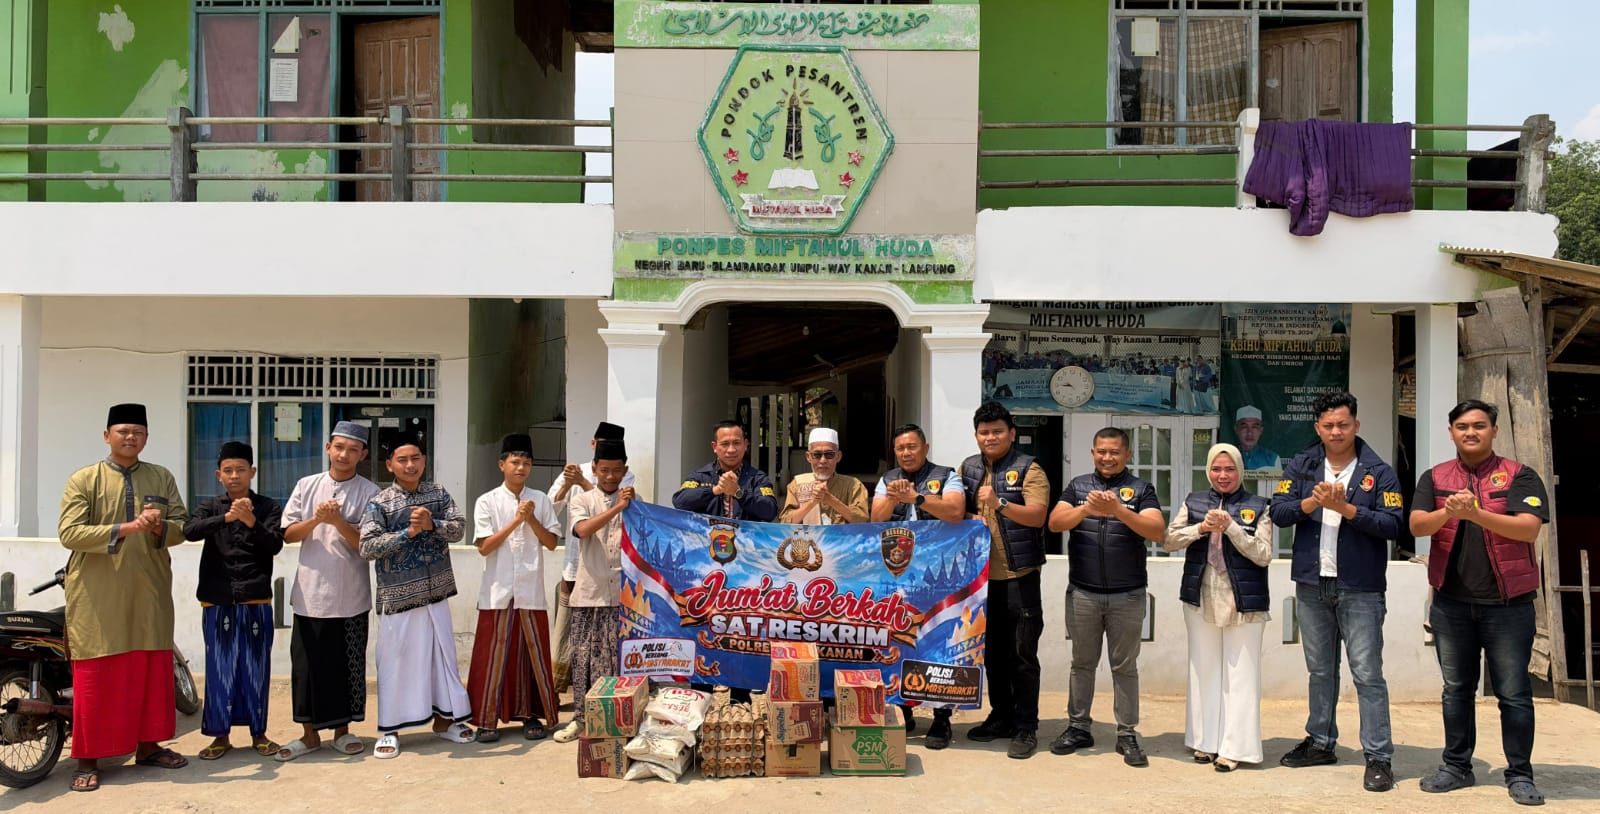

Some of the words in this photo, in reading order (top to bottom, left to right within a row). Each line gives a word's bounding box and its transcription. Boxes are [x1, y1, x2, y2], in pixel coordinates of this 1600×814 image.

[721, 68, 774, 138] PONDOK
[785, 64, 868, 141] PESANTREN
[657, 237, 746, 256] PONPES
[754, 237, 865, 257] MIFTAHUL
[874, 239, 935, 257] HUDA
[828, 263, 851, 274] WAY
[855, 264, 893, 274] KANAN
[901, 264, 956, 275] LAMPUNG
[1029, 313, 1102, 328] MIFTAHUL
[1106, 314, 1146, 328] HUDA
[994, 333, 1017, 341] Baru
[1103, 335, 1121, 345] Way
[1123, 335, 1152, 344] Kanan
[1158, 335, 1201, 345] Lampung
[1230, 338, 1261, 352] KBIHU
[1263, 339, 1313, 353] MIFTAHUL
[1315, 340, 1342, 353] HUDA
[686, 569, 797, 618] Jum'at
[801, 577, 914, 633] Berkah
[7, 616, 34, 624] SUZUKI
[711, 614, 763, 637] SAT
[768, 617, 889, 647] RESKRIM
[641, 642, 666, 653] POLISI
[729, 638, 771, 653] POLRE
[817, 646, 864, 659] KANAN
[925, 665, 953, 679] POLISI
[924, 683, 978, 696] MASYARAKAT
[856, 741, 884, 753] PSM
